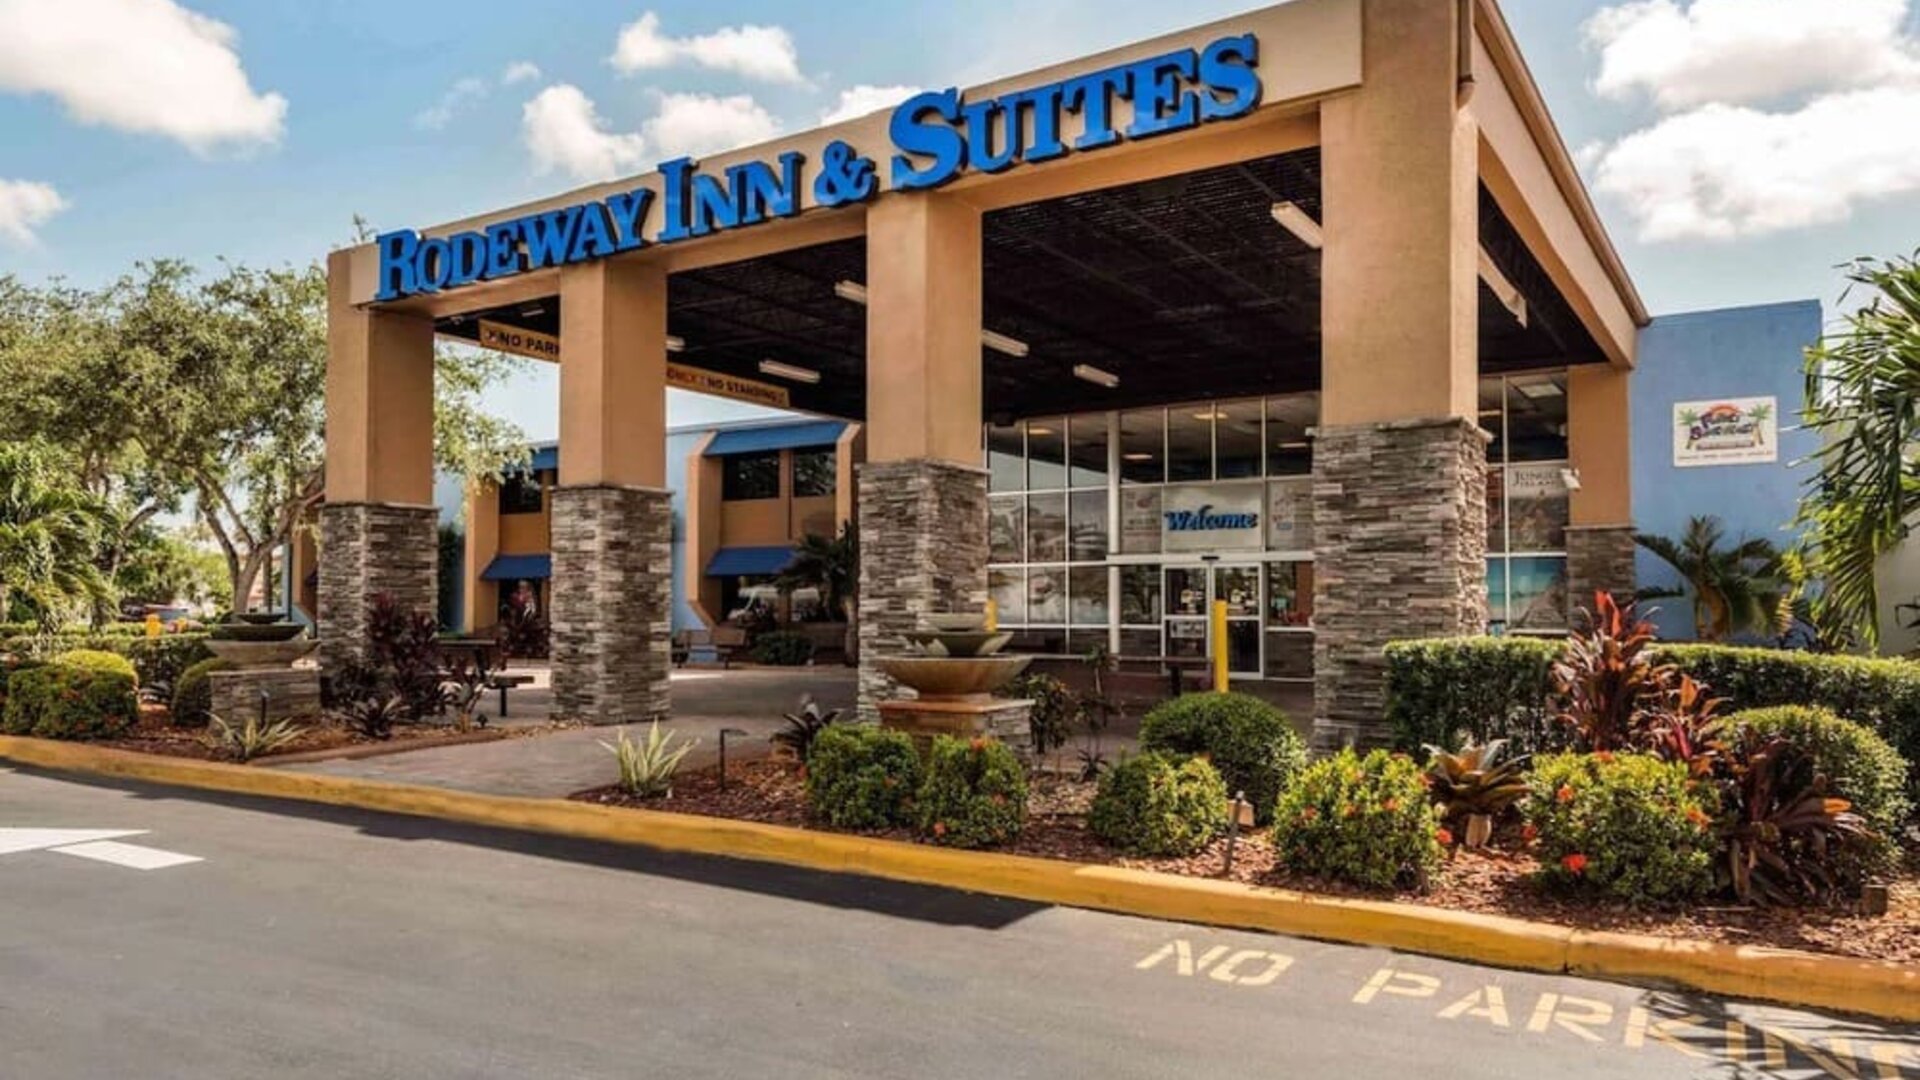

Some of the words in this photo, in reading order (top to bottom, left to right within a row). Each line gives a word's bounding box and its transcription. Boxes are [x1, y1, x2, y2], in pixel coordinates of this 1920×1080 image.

[375, 187, 656, 303] RODEWAY
[658, 155, 804, 245] INN
[813, 140, 879, 210] &
[889, 33, 1262, 193] SUITES
[1164, 504, 1258, 531] Welcome
[1135, 938, 1295, 987] NO
